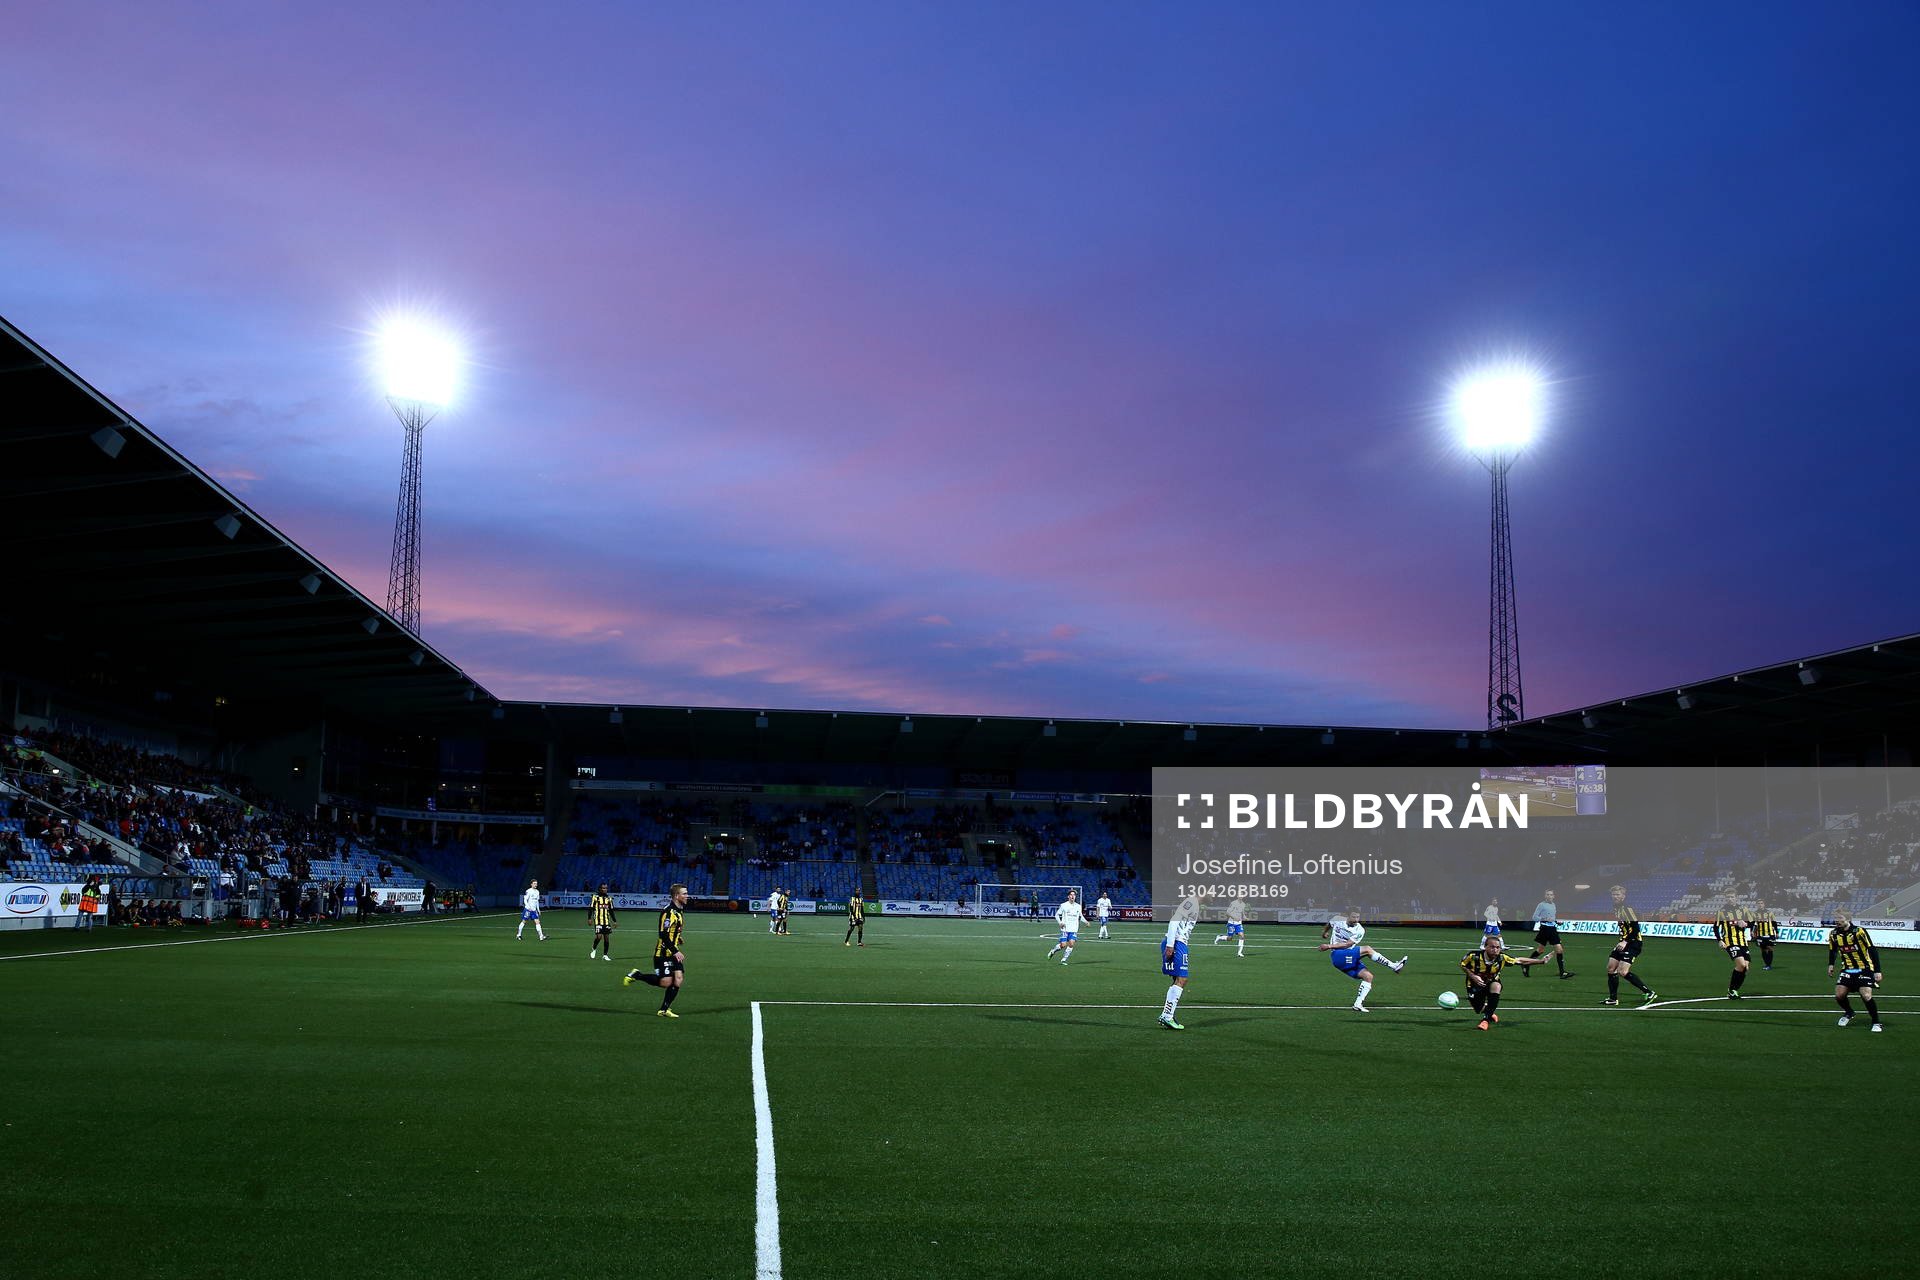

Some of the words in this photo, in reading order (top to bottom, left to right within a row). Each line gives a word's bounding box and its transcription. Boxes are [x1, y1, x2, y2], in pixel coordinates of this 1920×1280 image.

[1597, 772, 1604, 780] 2
[1579, 785, 1604, 793] 76:38
[1573, 921, 1608, 933] SIEMENS
[1653, 922, 1695, 937] SIEMENS
[664, 967, 671, 975] 6
